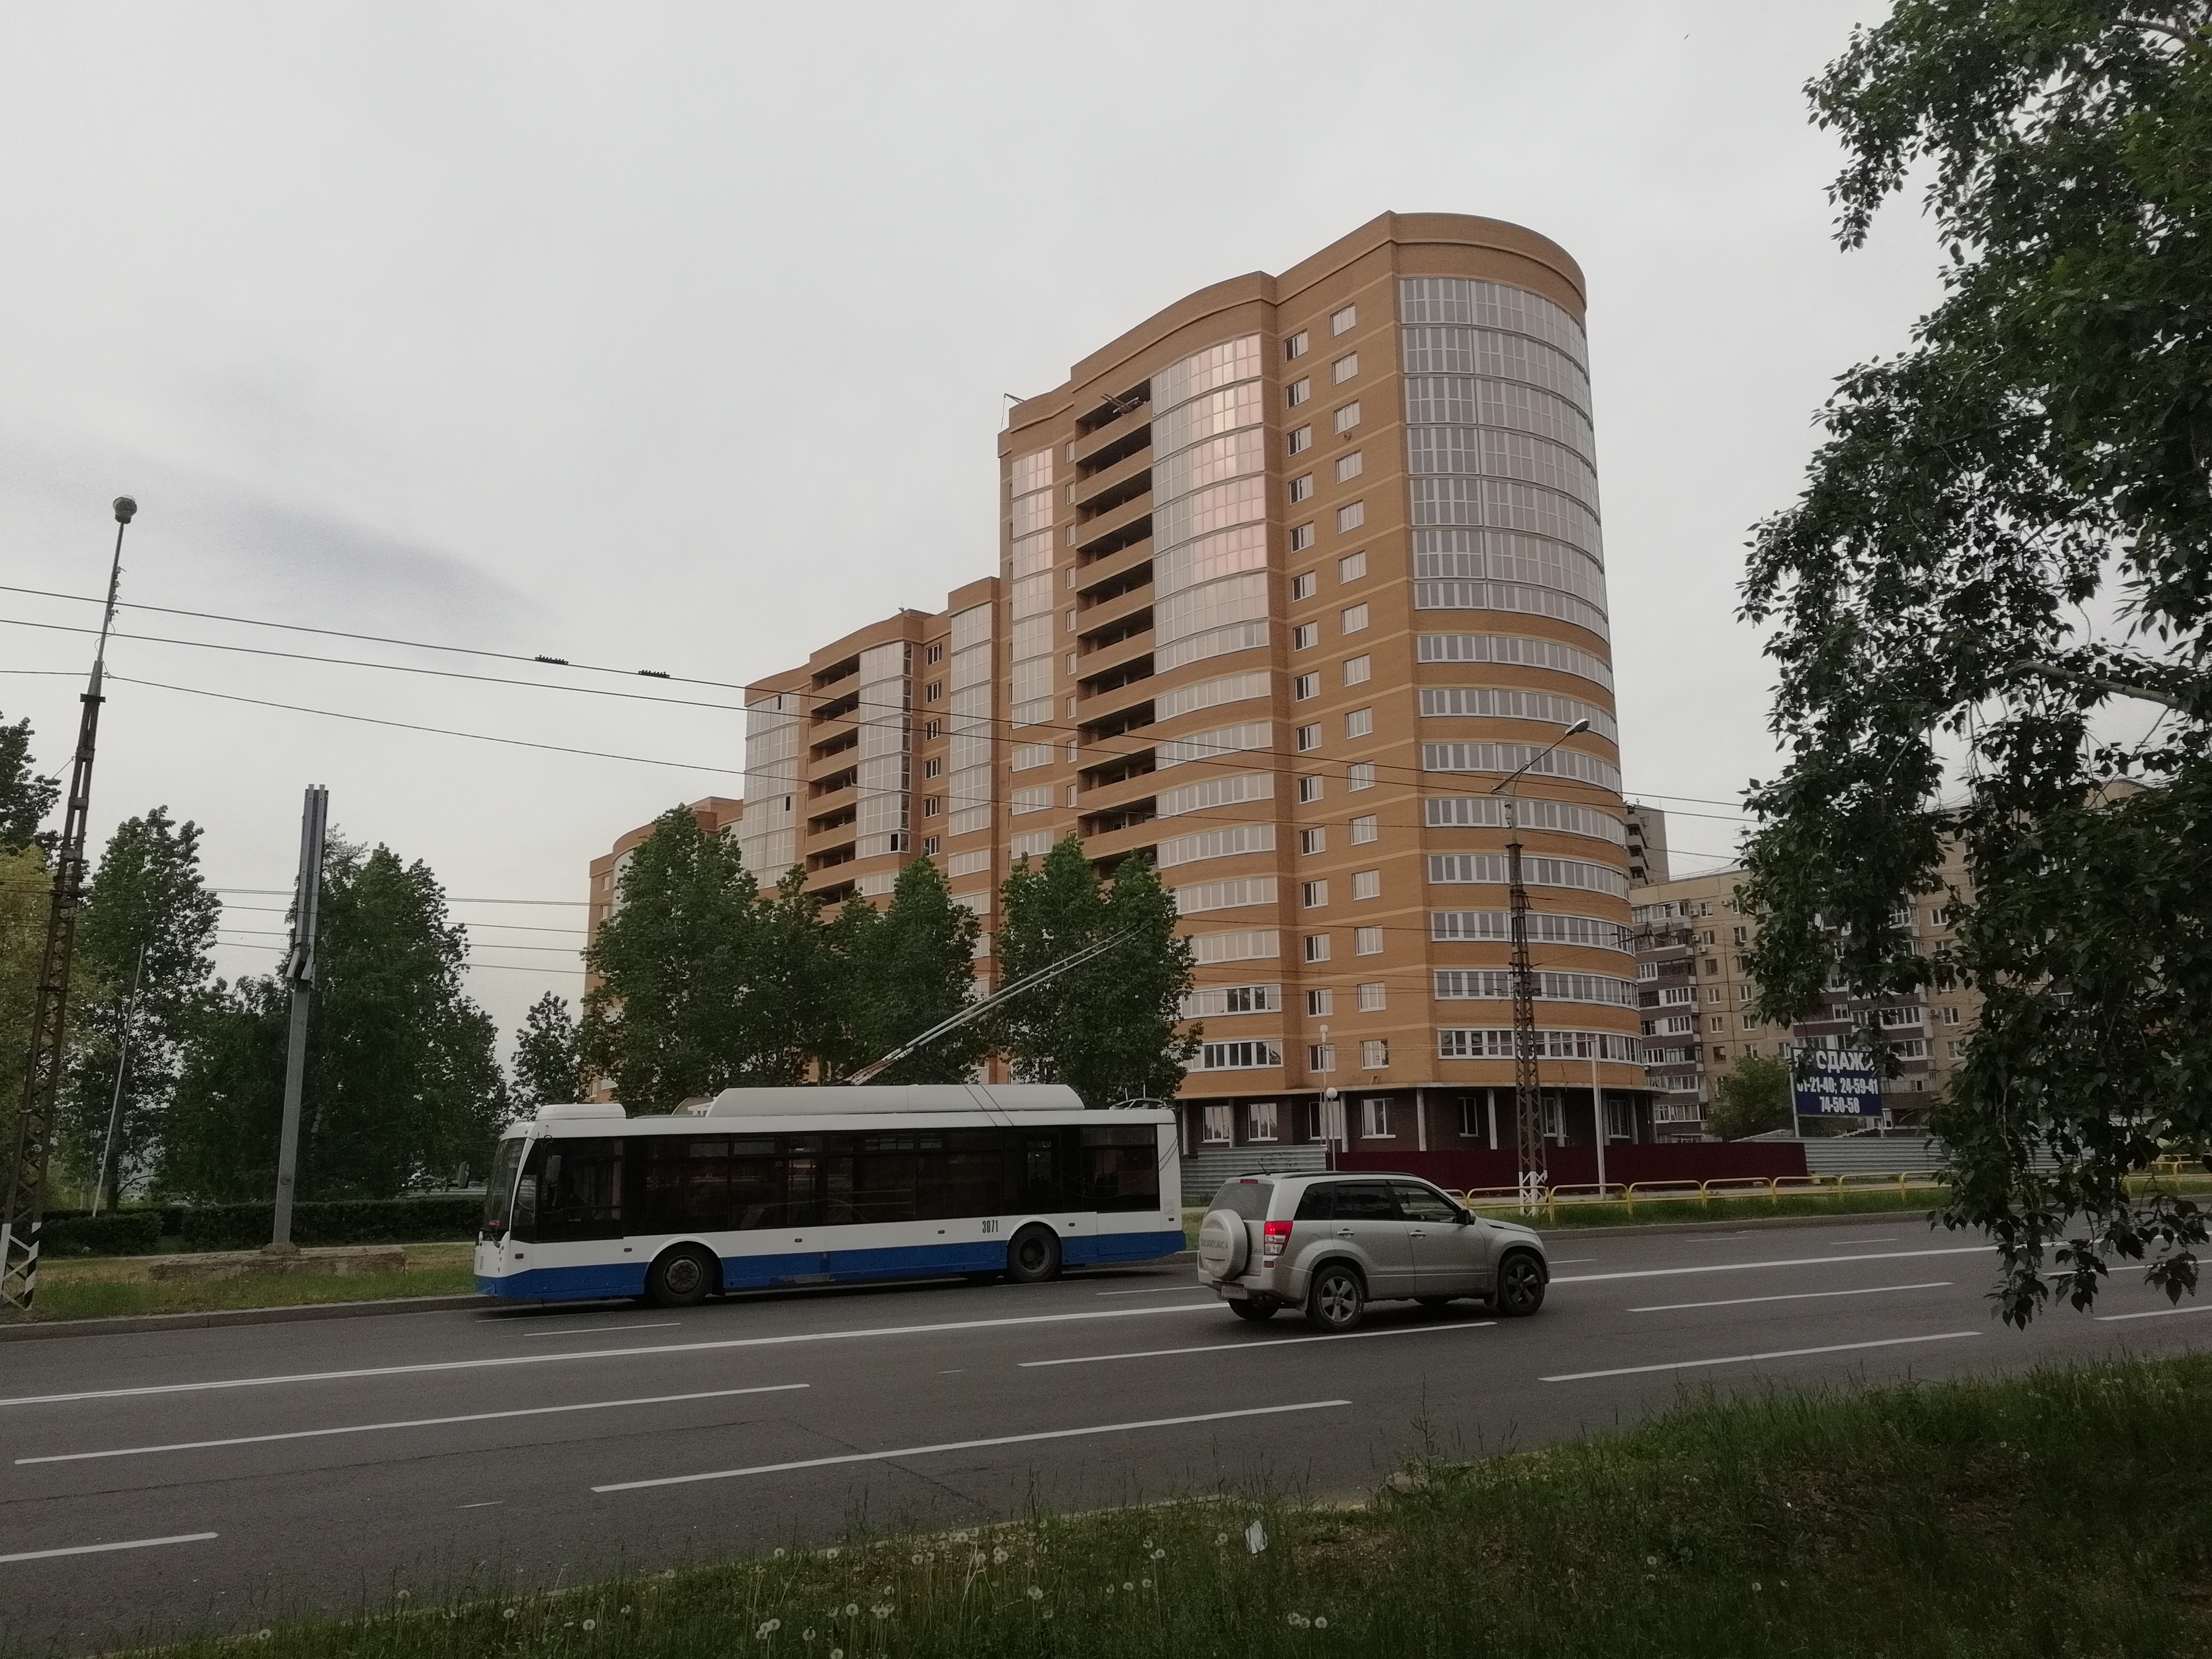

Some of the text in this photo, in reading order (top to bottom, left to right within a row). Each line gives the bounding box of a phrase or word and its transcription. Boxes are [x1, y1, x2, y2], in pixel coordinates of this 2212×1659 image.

[1793, 1049, 1875, 1074] ПОДАЖА
[1840, 1077, 1879, 1095] 24-59-41
[1819, 1096, 1860, 1113] 74-50-58
[982, 1219, 998, 1234] 3071
[1200, 1238, 1228, 1249] SUZUKI
